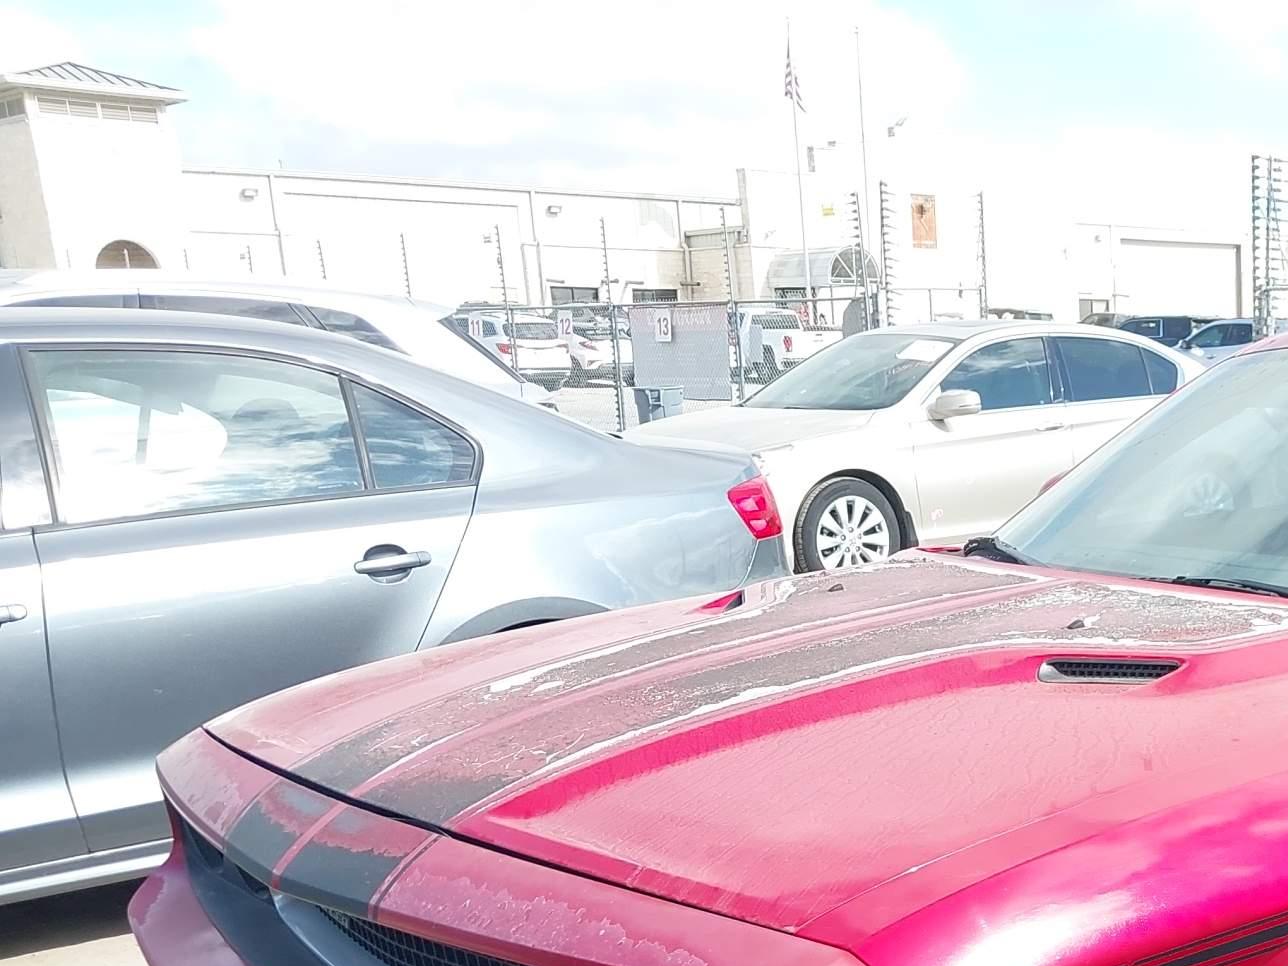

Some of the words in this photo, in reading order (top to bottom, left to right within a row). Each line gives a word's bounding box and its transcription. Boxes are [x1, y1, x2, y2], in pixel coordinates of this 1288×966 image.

[470, 319, 480, 337] 11
[560, 318, 571, 335] 12
[656, 317, 669, 336] 13
